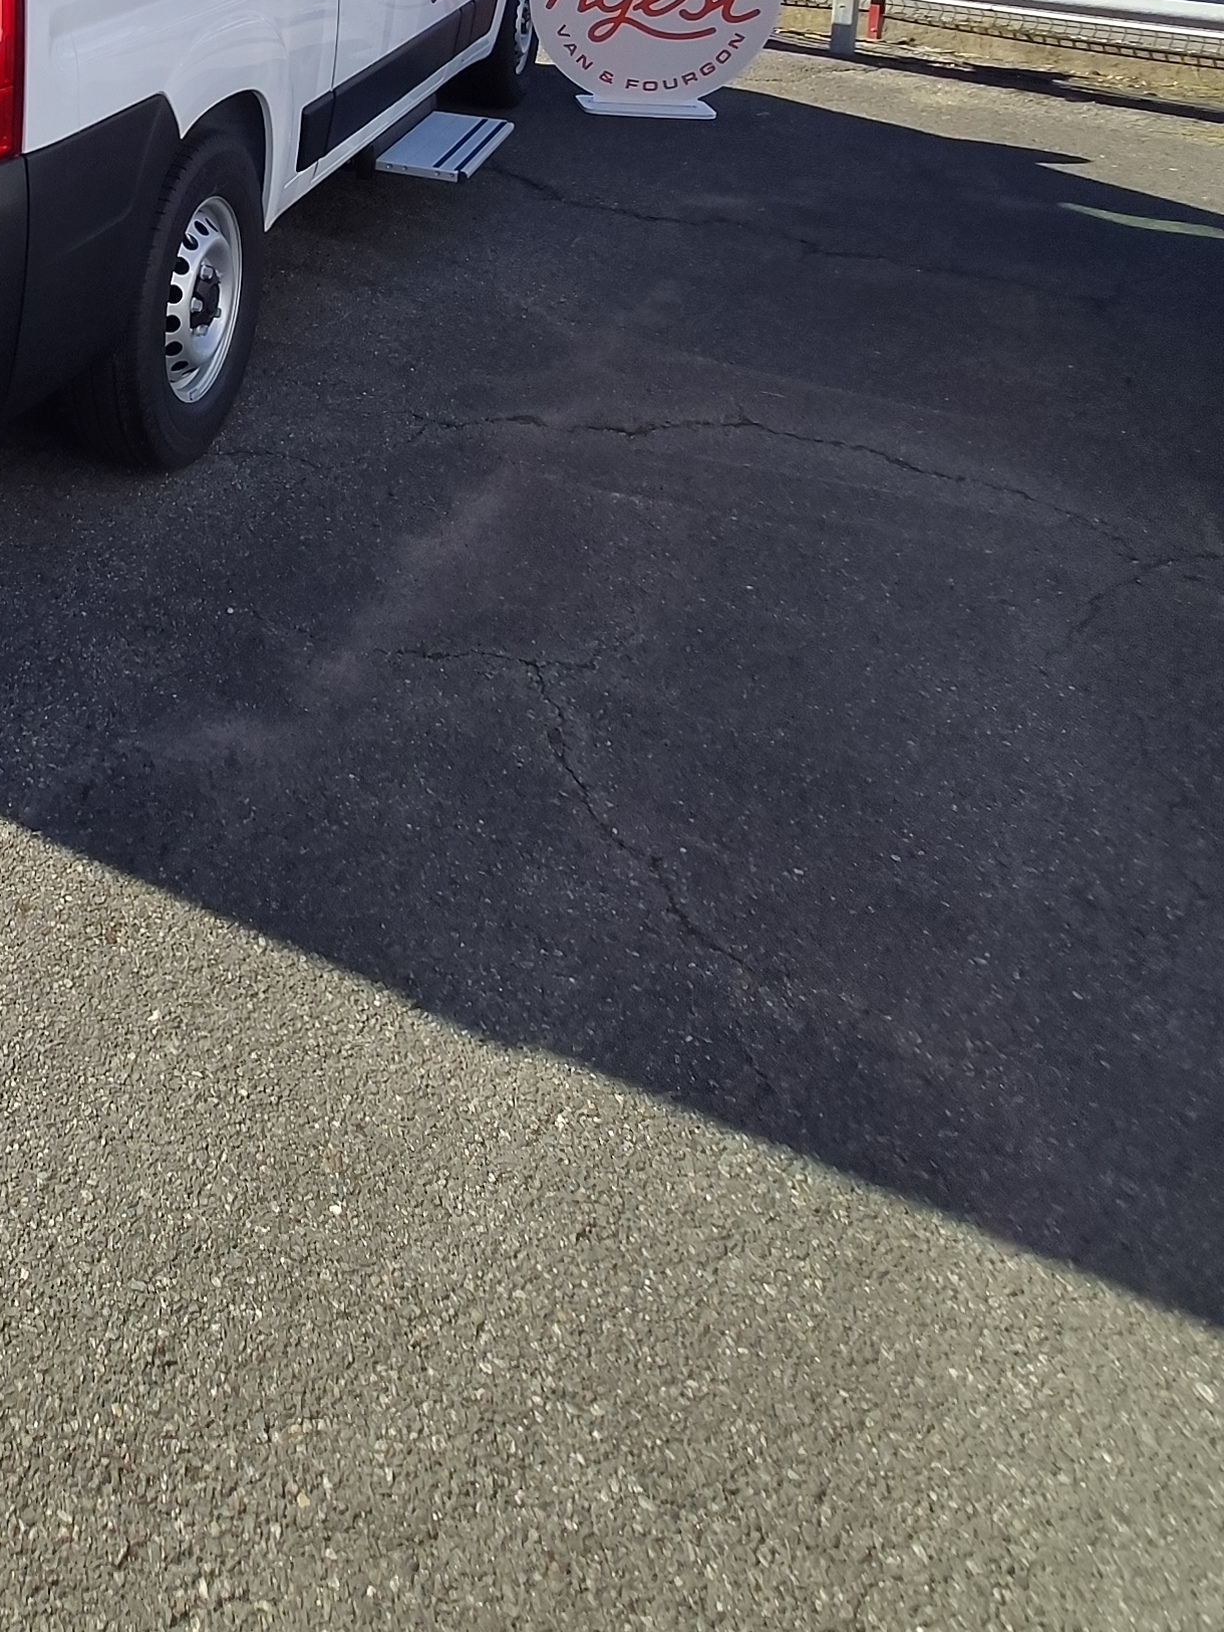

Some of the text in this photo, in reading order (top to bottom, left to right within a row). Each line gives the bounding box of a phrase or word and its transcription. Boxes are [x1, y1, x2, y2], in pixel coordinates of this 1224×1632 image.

[557, 24, 746, 91] VAN & FOURGON
